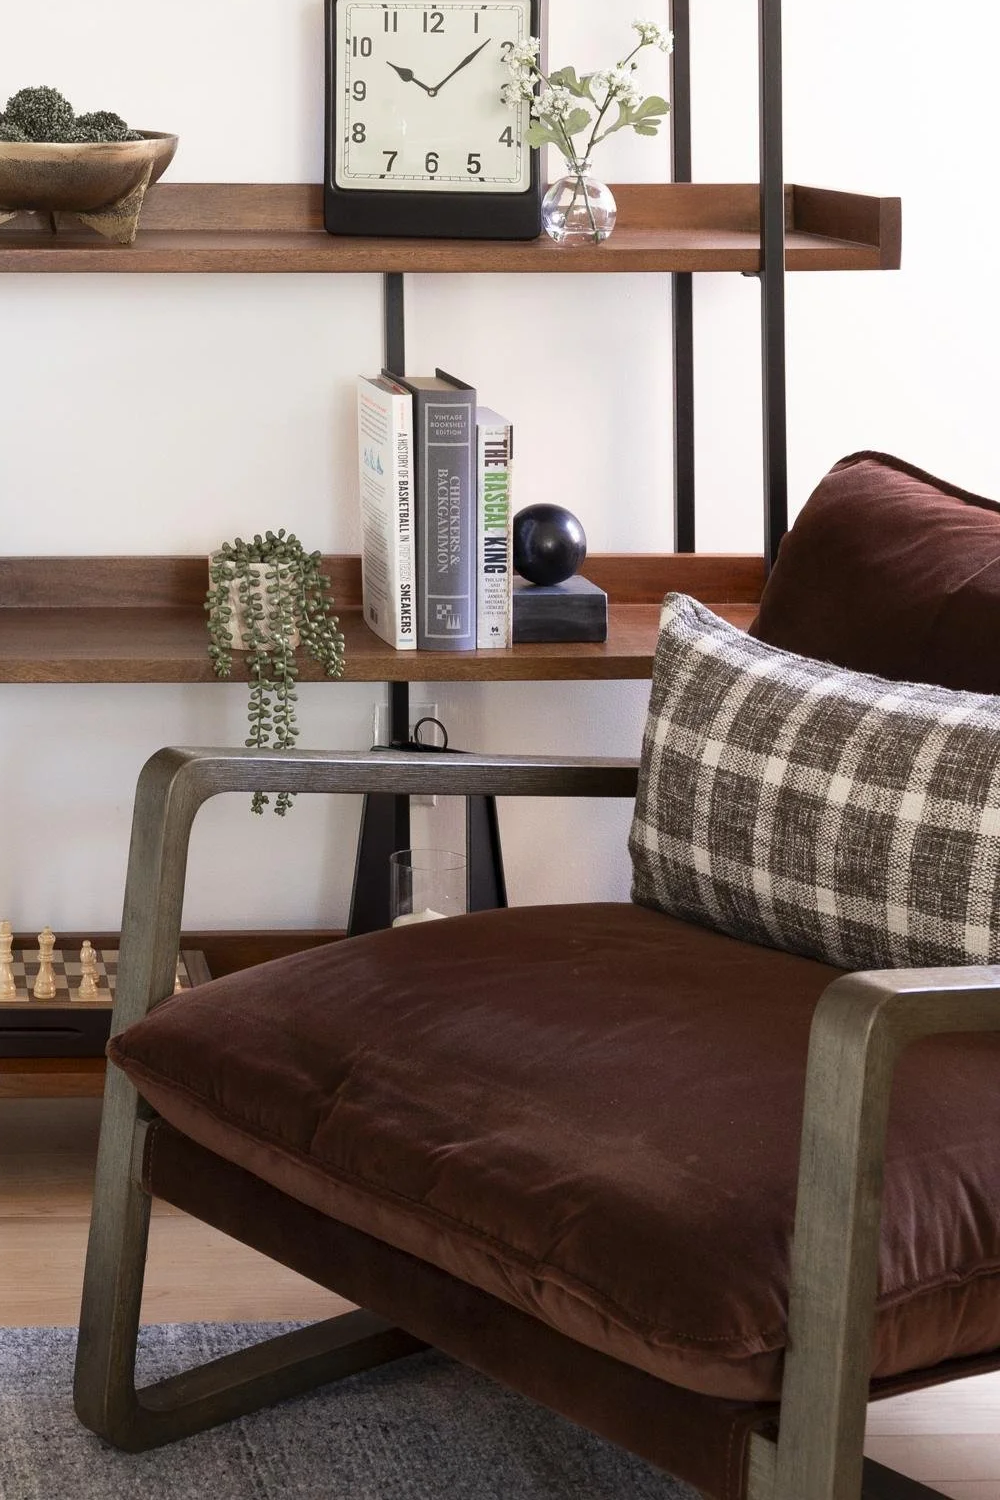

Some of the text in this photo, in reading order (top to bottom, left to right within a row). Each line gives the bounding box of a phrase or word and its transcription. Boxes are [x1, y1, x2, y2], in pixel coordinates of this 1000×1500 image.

[383, 11, 479, 33] 11 12 1
[352, 36, 372, 57] 10
[352, 80, 367, 101] 9
[351, 122, 514, 147] 8 4
[382, 151, 482, 174] 7 6 5
[398, 440, 408, 468] HISTORY
[484, 439, 508, 467] THE
[398, 480, 409, 533] BASKETBALL
[484, 472, 508, 531] RASCAL
[437, 468, 449, 574] BACKGAMMON
[450, 475, 461, 565] CHECKERS &
[400, 534, 409, 542] IN
[484, 537, 508, 574] KING
[400, 583, 412, 634] SNEAKERS
